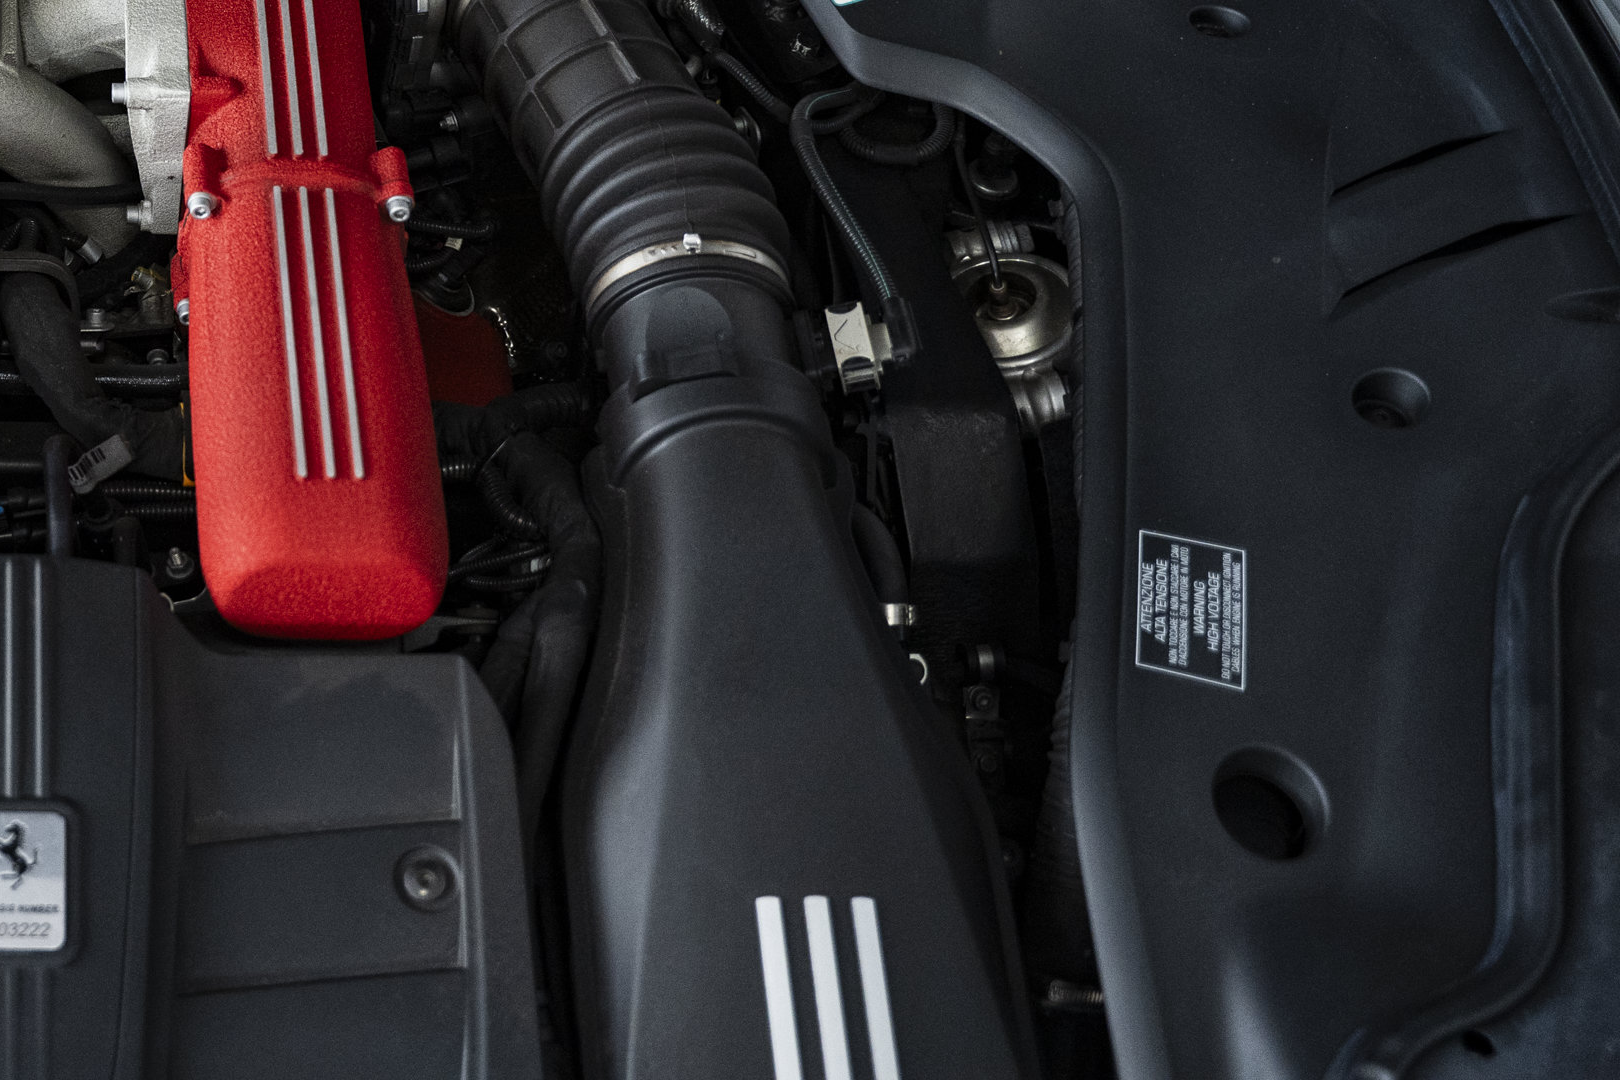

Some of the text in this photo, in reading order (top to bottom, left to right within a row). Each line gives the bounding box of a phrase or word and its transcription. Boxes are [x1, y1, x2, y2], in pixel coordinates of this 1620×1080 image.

[1170, 544, 1179, 558] CAVI
[1180, 546, 1189, 565] MOTO
[1170, 562, 1178, 594] STACCARE
[1180, 566, 1188, 574] IN
[1140, 562, 1153, 632] ATTENZIONE
[1180, 574, 1188, 602] MOTORE
[1222, 579, 1230, 619] DISCONNECT
[1154, 558, 1167, 642] ALTA TENSIONE
[1170, 595, 1178, 610] NON
[1179, 602, 1188, 617] CON
[1193, 580, 1205, 636] WARNING
[1207, 571, 1219, 652] HIGH VOLTAGE
[1222, 618, 1230, 629] OR
[1232, 561, 1240, 673] CABLES WHEN ENGINE IS RUNNING
[1169, 616, 1178, 647] TOCCARE
[1222, 629, 1230, 652] TOUCH
[1169, 647, 1177, 664] NON
[1222, 652, 1230, 668] NOT
[1222, 668, 1230, 679] DO
